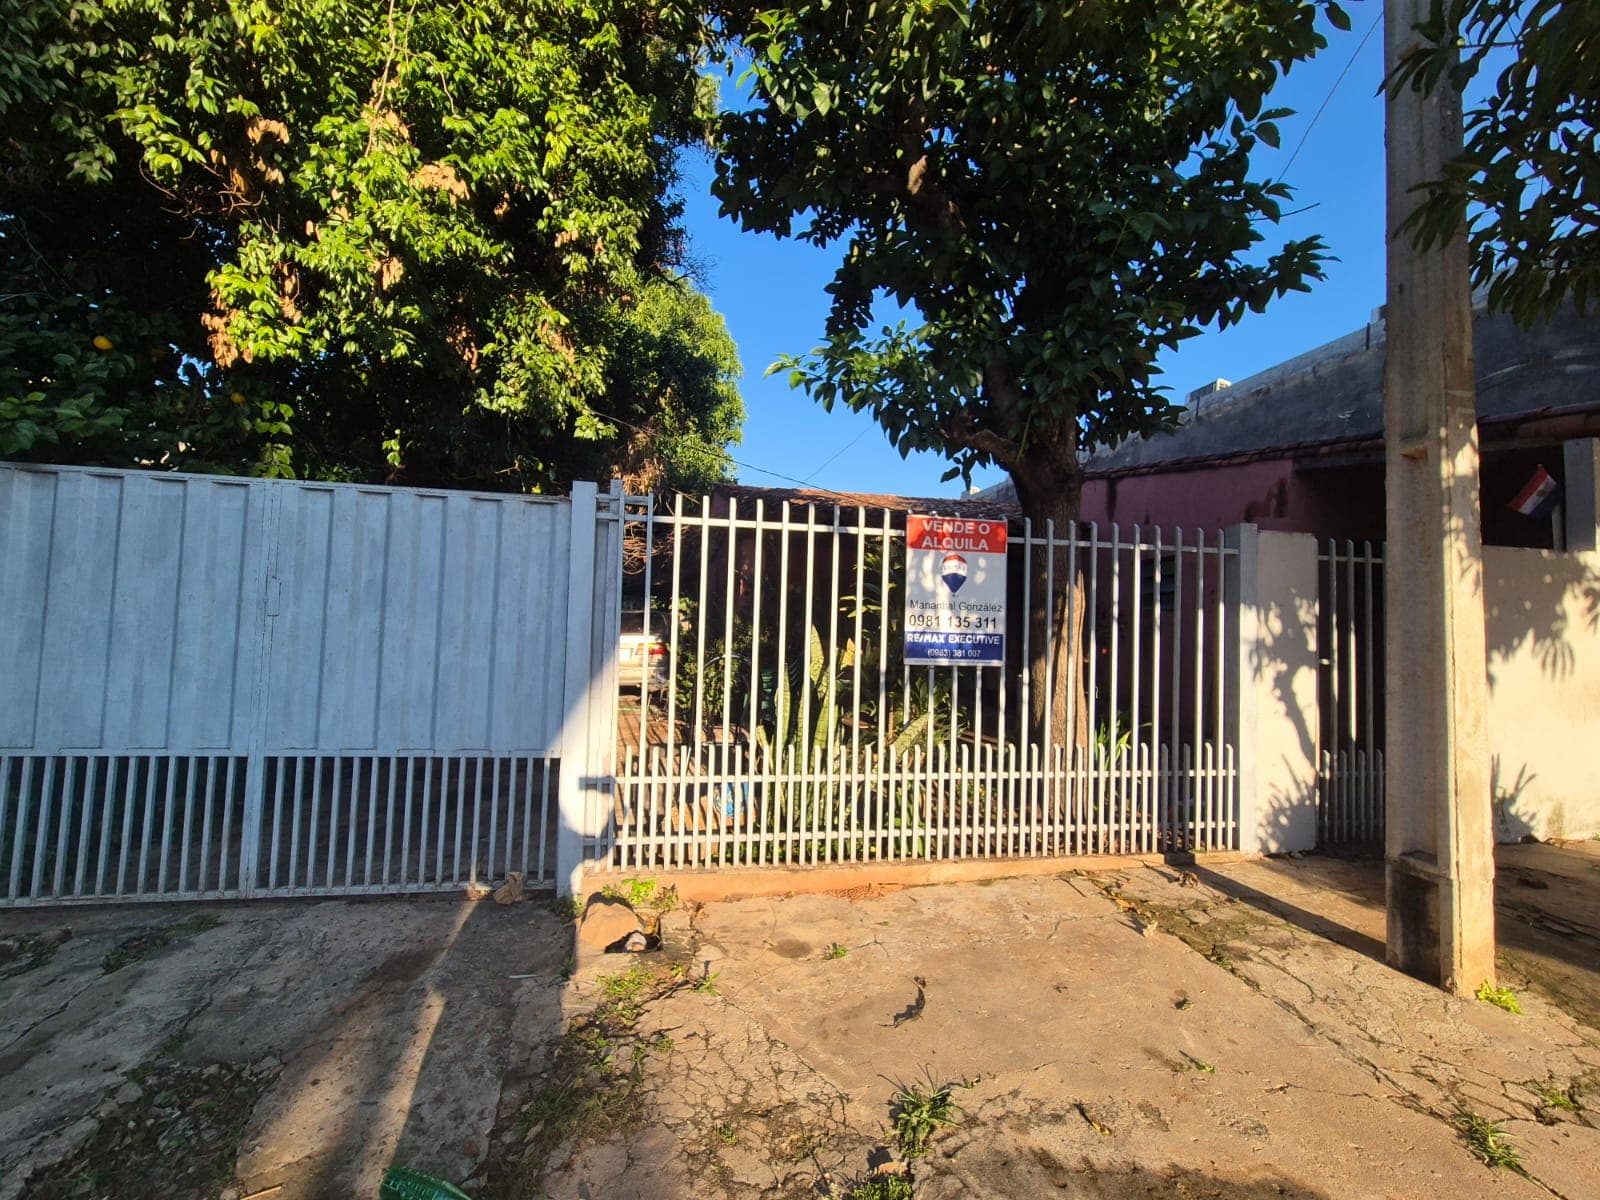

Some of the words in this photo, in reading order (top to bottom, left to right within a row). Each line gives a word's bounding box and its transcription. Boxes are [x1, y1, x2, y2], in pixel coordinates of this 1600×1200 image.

[922, 520, 975, 534] VENDE
[978, 523, 990, 535] O
[922, 536, 989, 551] ALQUILA
[959, 601, 1002, 612] González
[909, 614, 940, 627] 0981
[949, 616, 970, 628] 135
[975, 617, 996, 629] 311
[907, 633, 945, 643] RE/MAX
[948, 634, 1001, 645] EXECUTIVE
